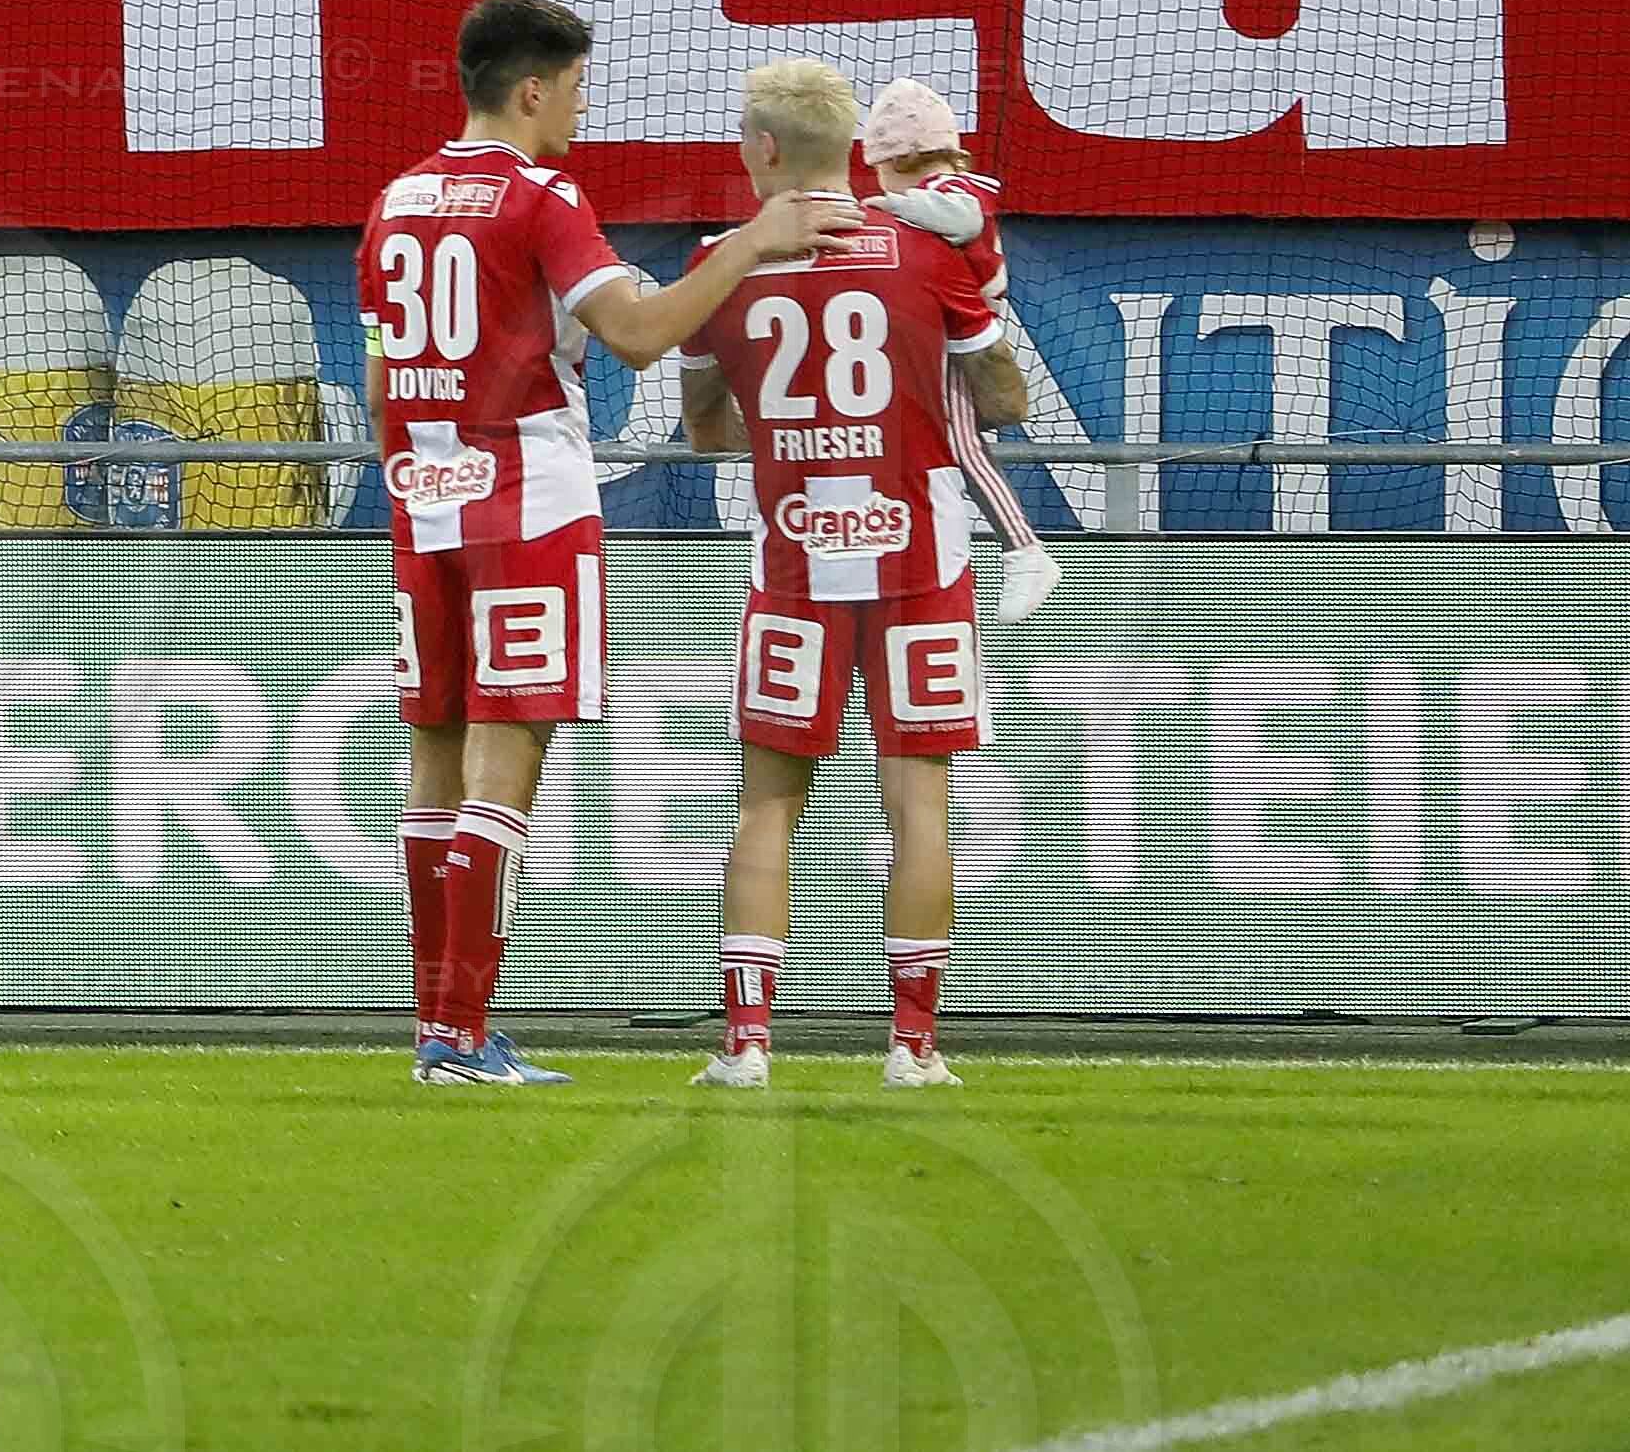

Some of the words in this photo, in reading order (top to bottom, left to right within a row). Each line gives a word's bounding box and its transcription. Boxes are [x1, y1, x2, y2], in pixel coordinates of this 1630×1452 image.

[377, 233, 478, 361] 30
[742, 289, 894, 421] 28
[772, 425, 884, 461] FRIESER
